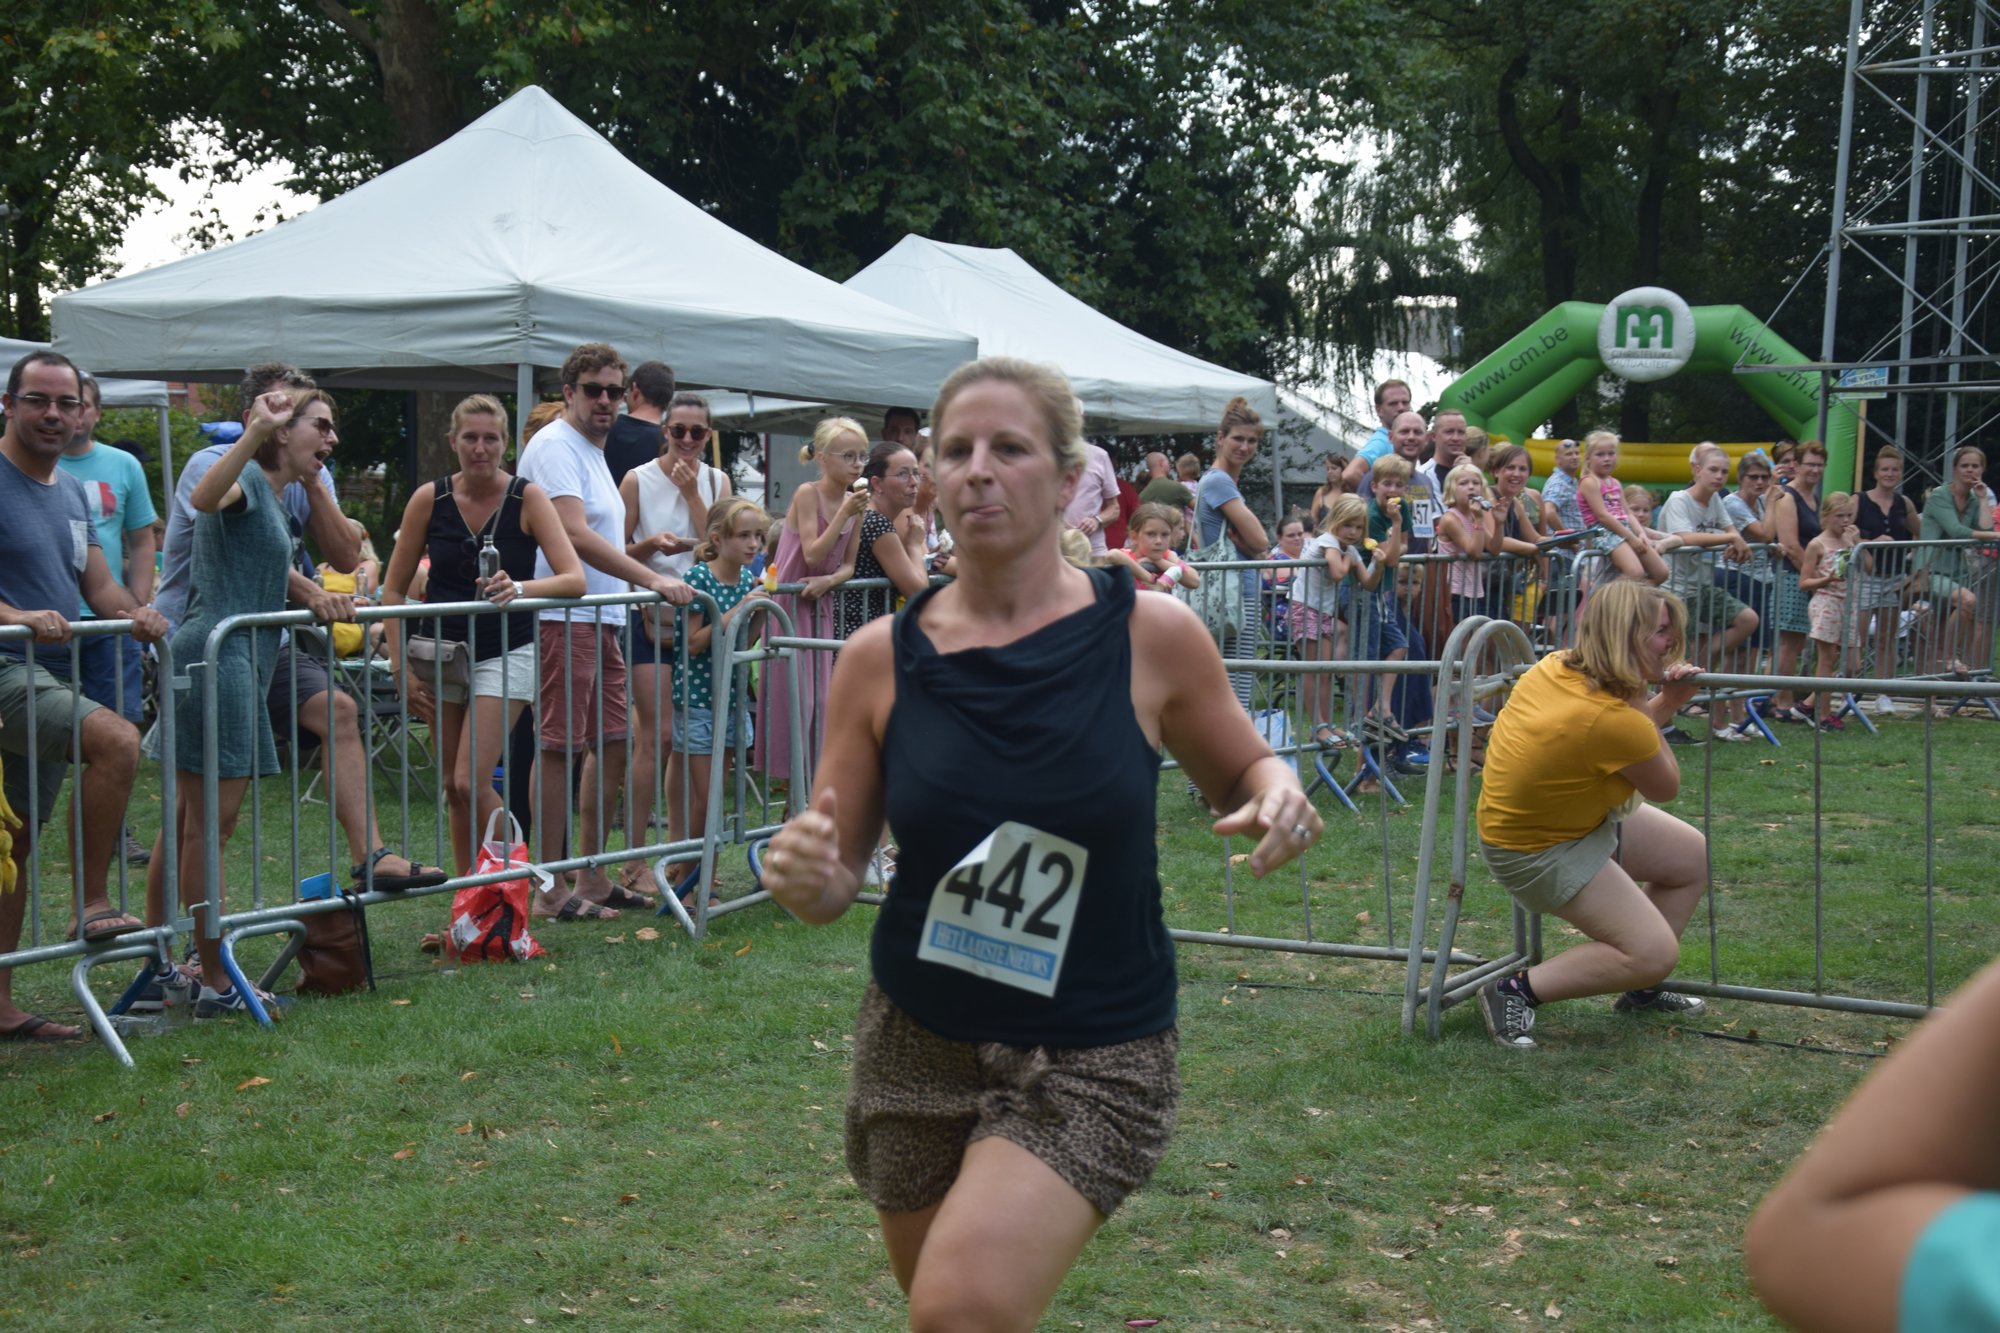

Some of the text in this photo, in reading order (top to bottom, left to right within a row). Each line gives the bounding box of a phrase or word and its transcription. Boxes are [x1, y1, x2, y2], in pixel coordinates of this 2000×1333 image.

[1459, 326, 1568, 405] www.cm.be
[774, 481, 781, 498] 2
[944, 841, 1074, 941] 442
[935, 923, 1051, 976] HET LAATSTE NIEUWS
